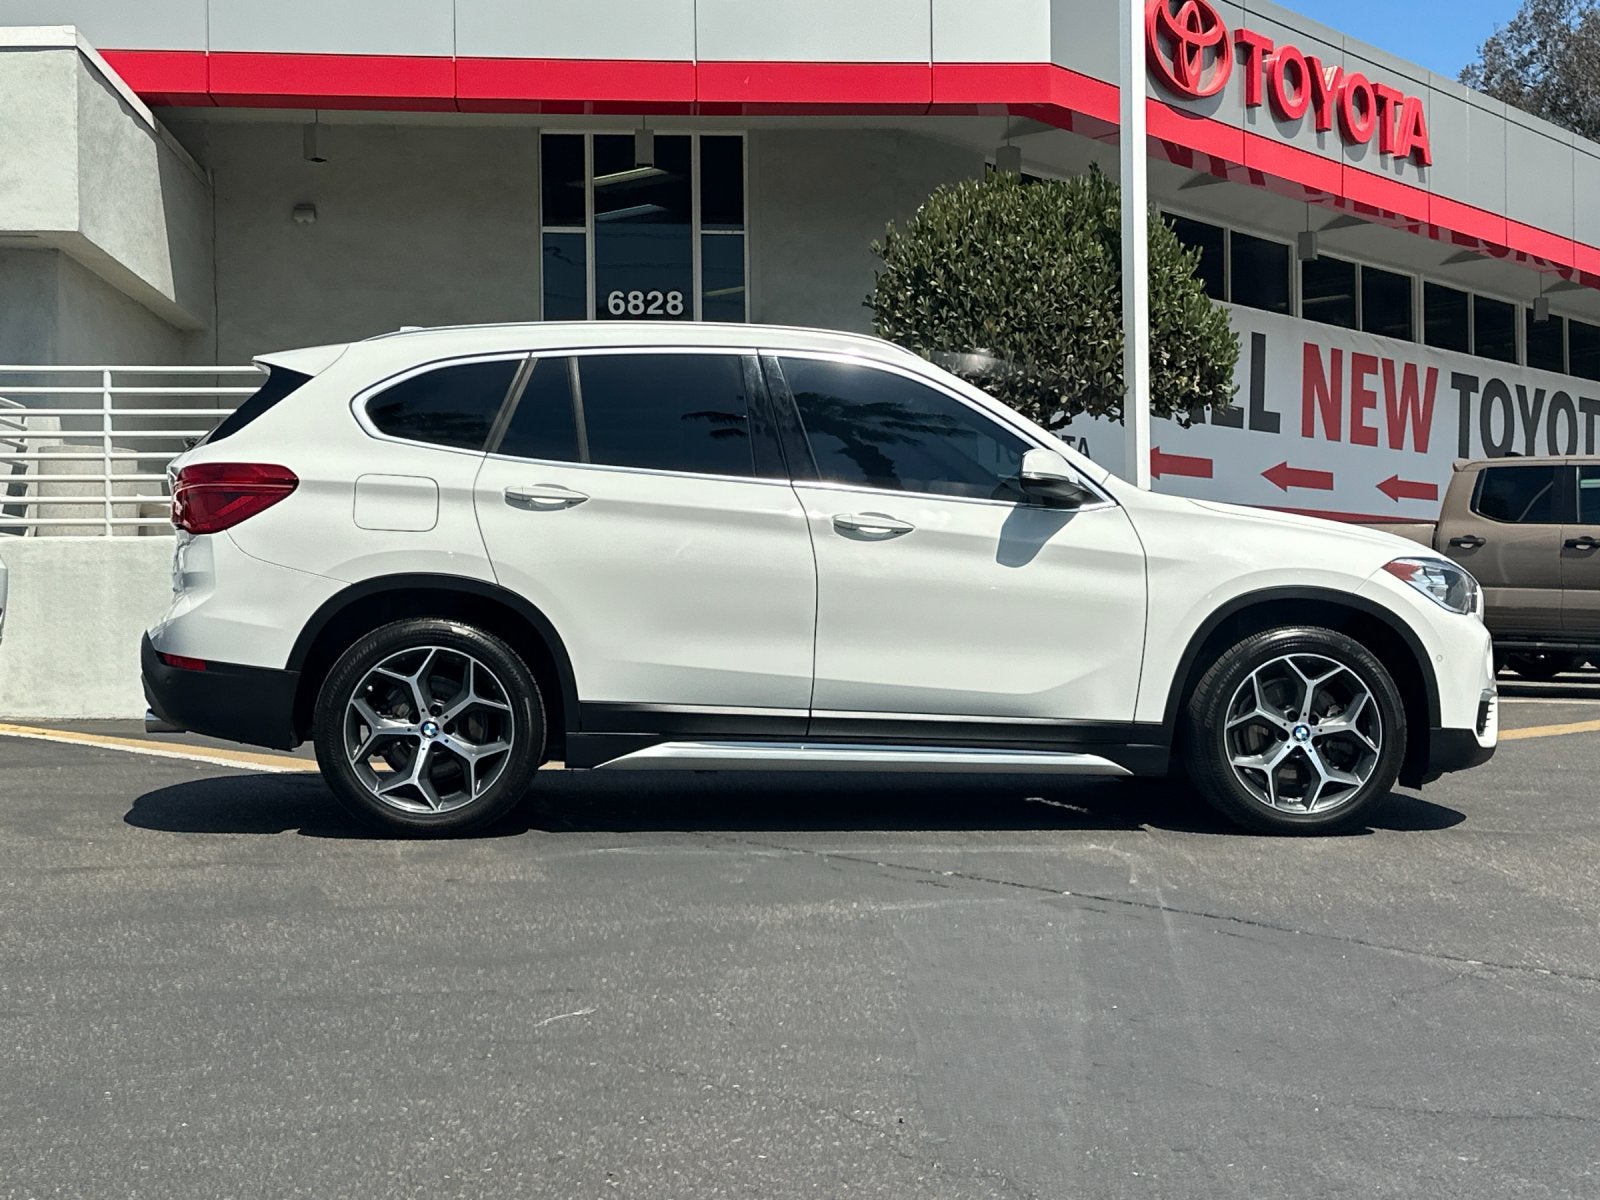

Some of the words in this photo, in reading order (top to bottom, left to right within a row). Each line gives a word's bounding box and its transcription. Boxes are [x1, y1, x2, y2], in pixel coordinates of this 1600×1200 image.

[1234, 28, 1432, 166] TOYOTA
[608, 290, 684, 315] 6828
[1301, 341, 1439, 454] NEW
